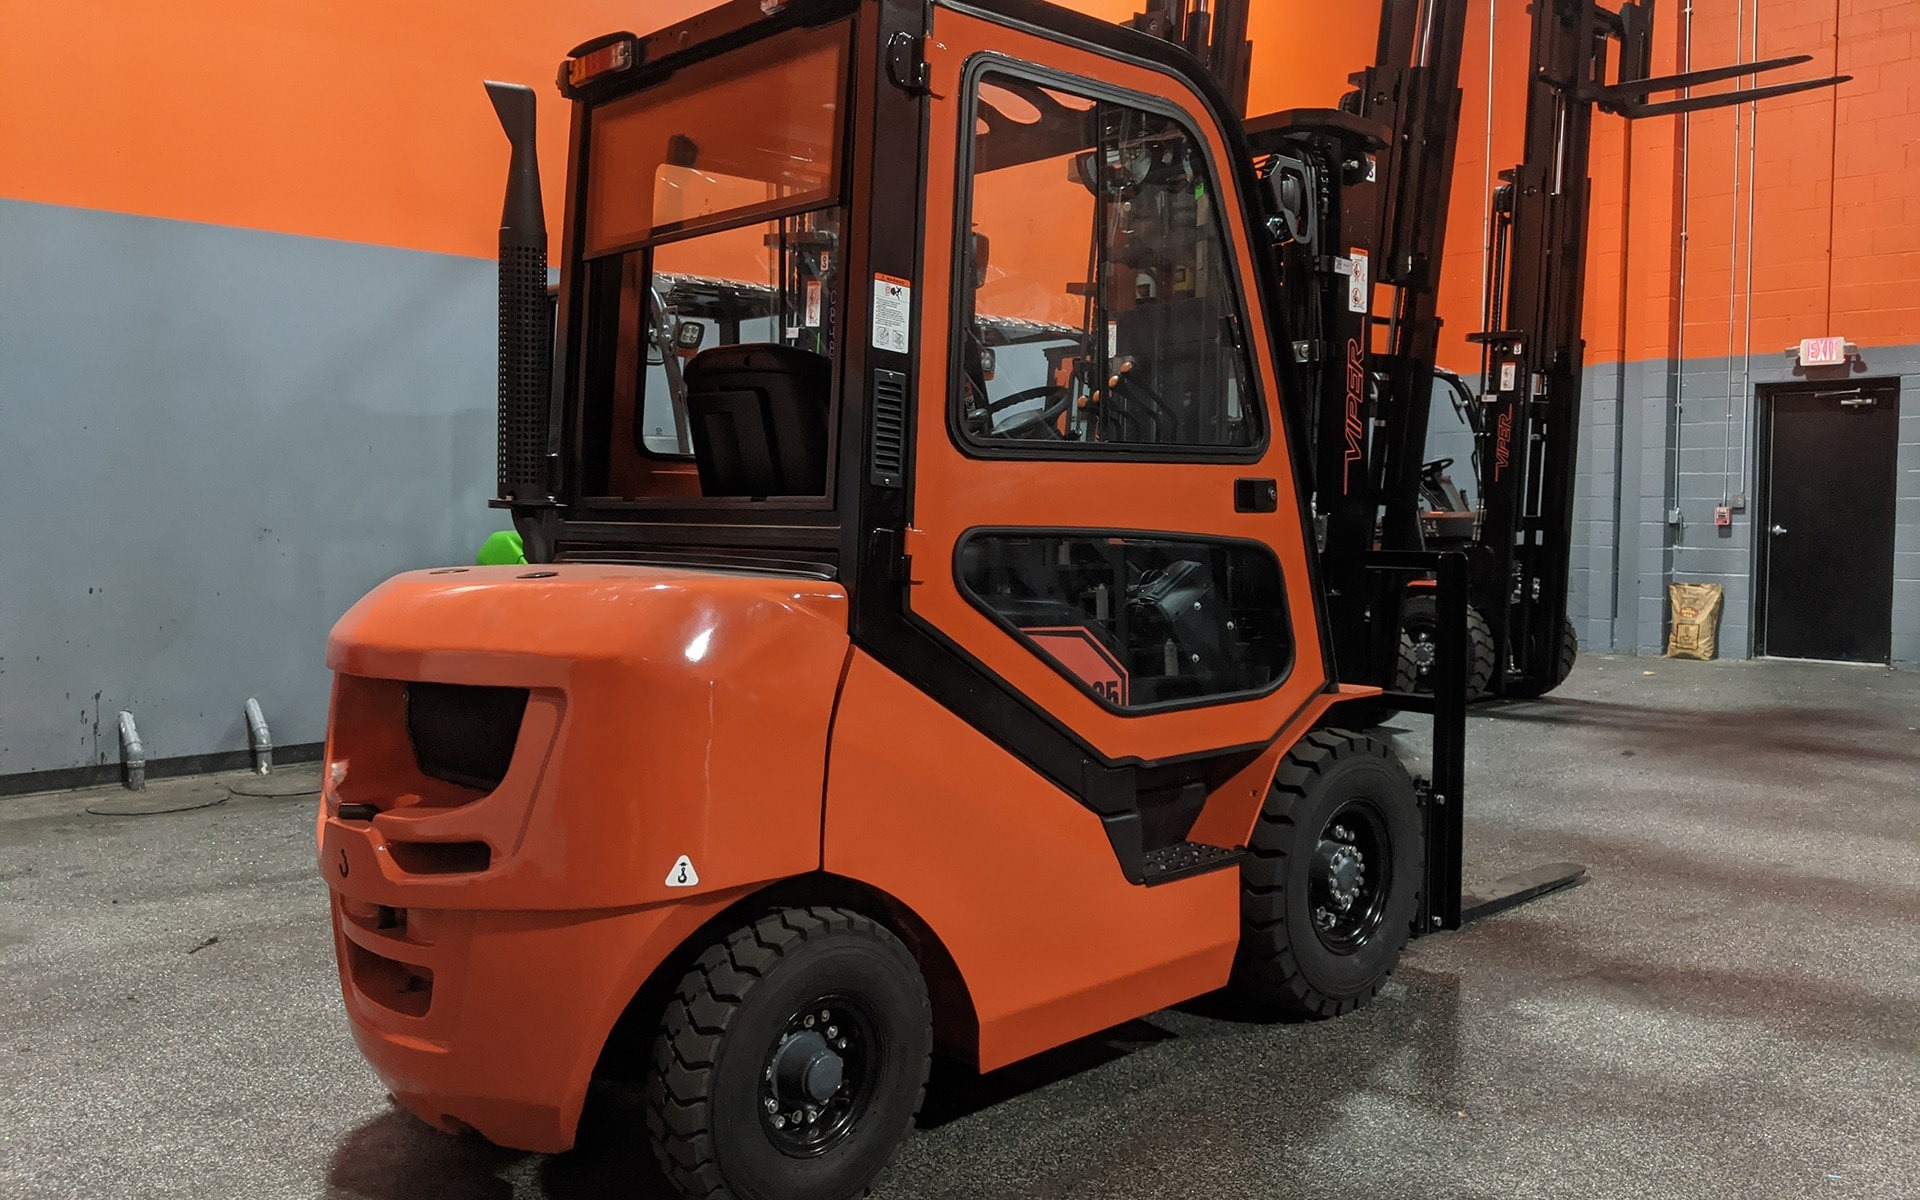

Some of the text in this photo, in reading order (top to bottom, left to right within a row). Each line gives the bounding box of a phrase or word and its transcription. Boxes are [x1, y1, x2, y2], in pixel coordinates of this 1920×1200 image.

[1807, 339, 1839, 361] EXIT
[1344, 316, 1365, 495] VIPER
[1495, 403, 1513, 482] VIPER
